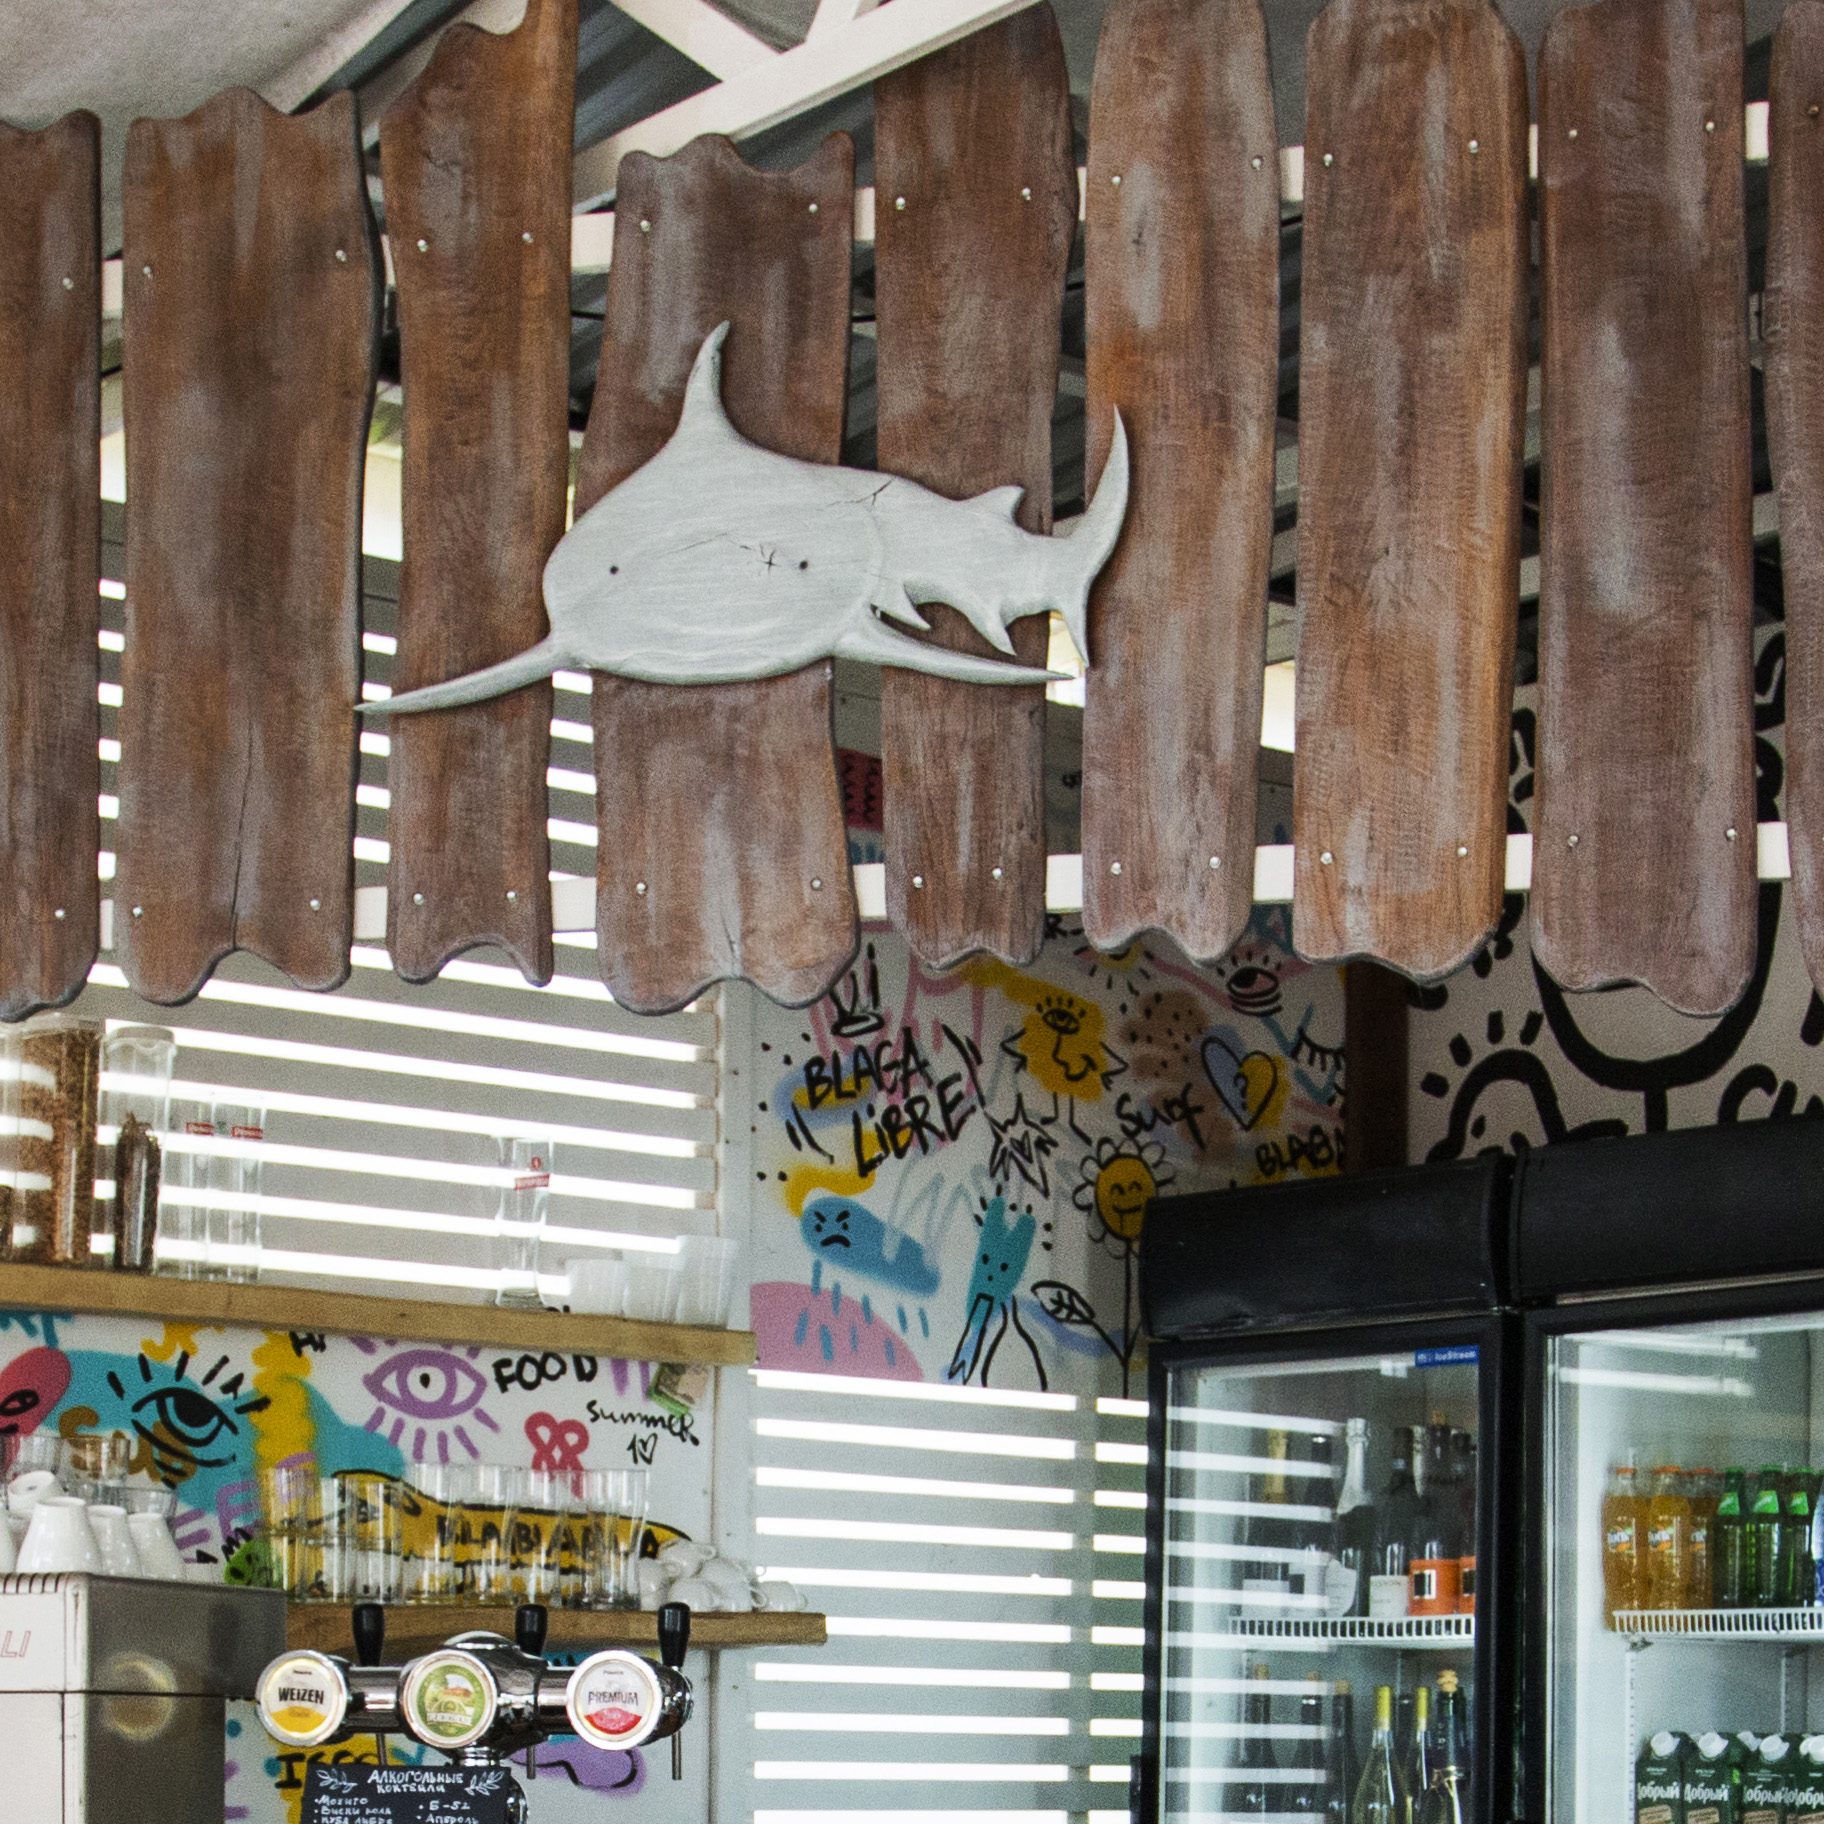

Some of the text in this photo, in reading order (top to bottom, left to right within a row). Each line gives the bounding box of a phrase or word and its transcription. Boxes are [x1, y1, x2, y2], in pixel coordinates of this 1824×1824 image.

[804, 1026, 933, 1110] BLAGA
[853, 1072, 976, 1178] LIBRE
[278, 1687, 325, 1706] WEIZEN
[588, 1690, 639, 1707] PREMIUM
